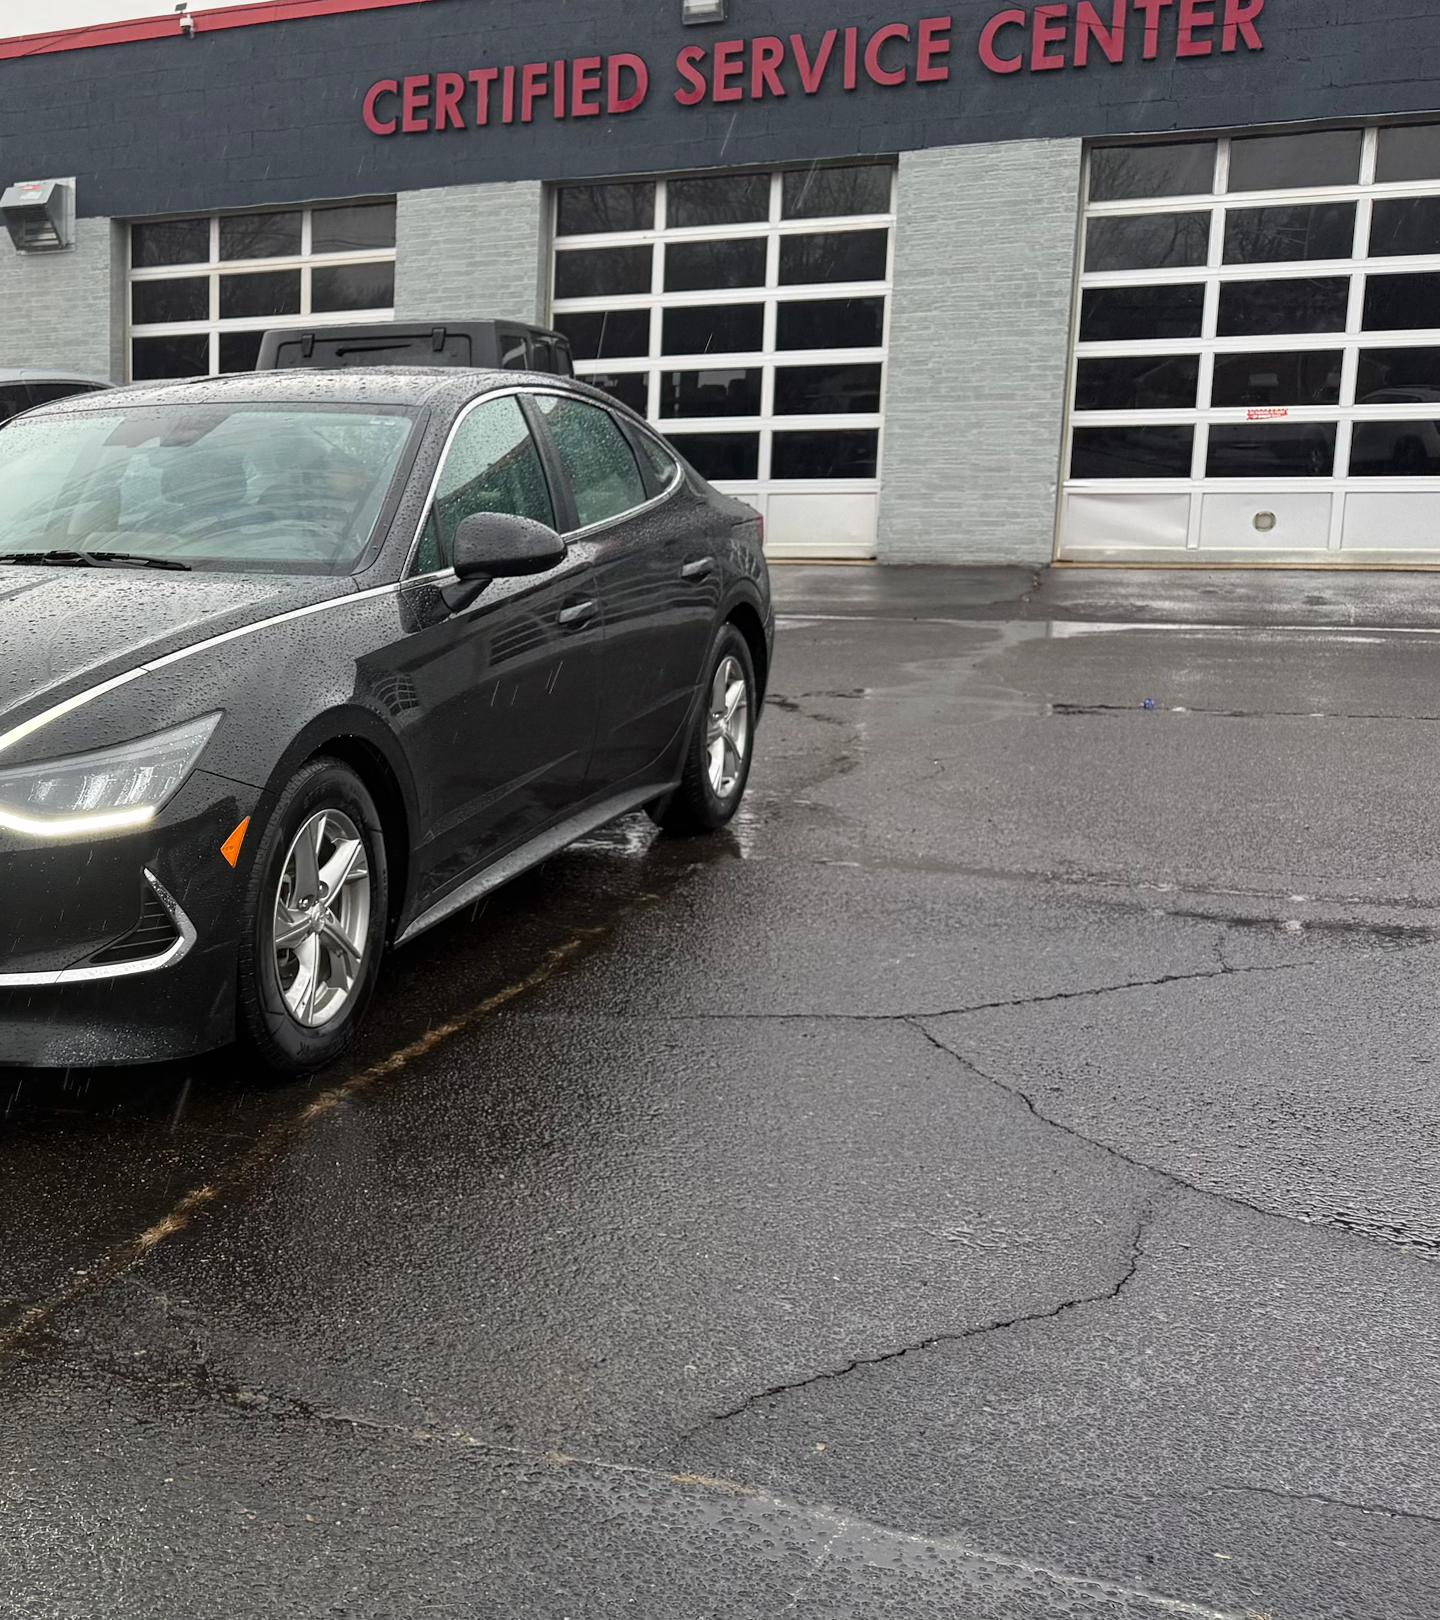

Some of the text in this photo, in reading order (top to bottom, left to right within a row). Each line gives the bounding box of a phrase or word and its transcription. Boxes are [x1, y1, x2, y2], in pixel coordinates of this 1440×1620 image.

[362, 0, 1264, 136] CERTIFIED SERVICE CENTER
